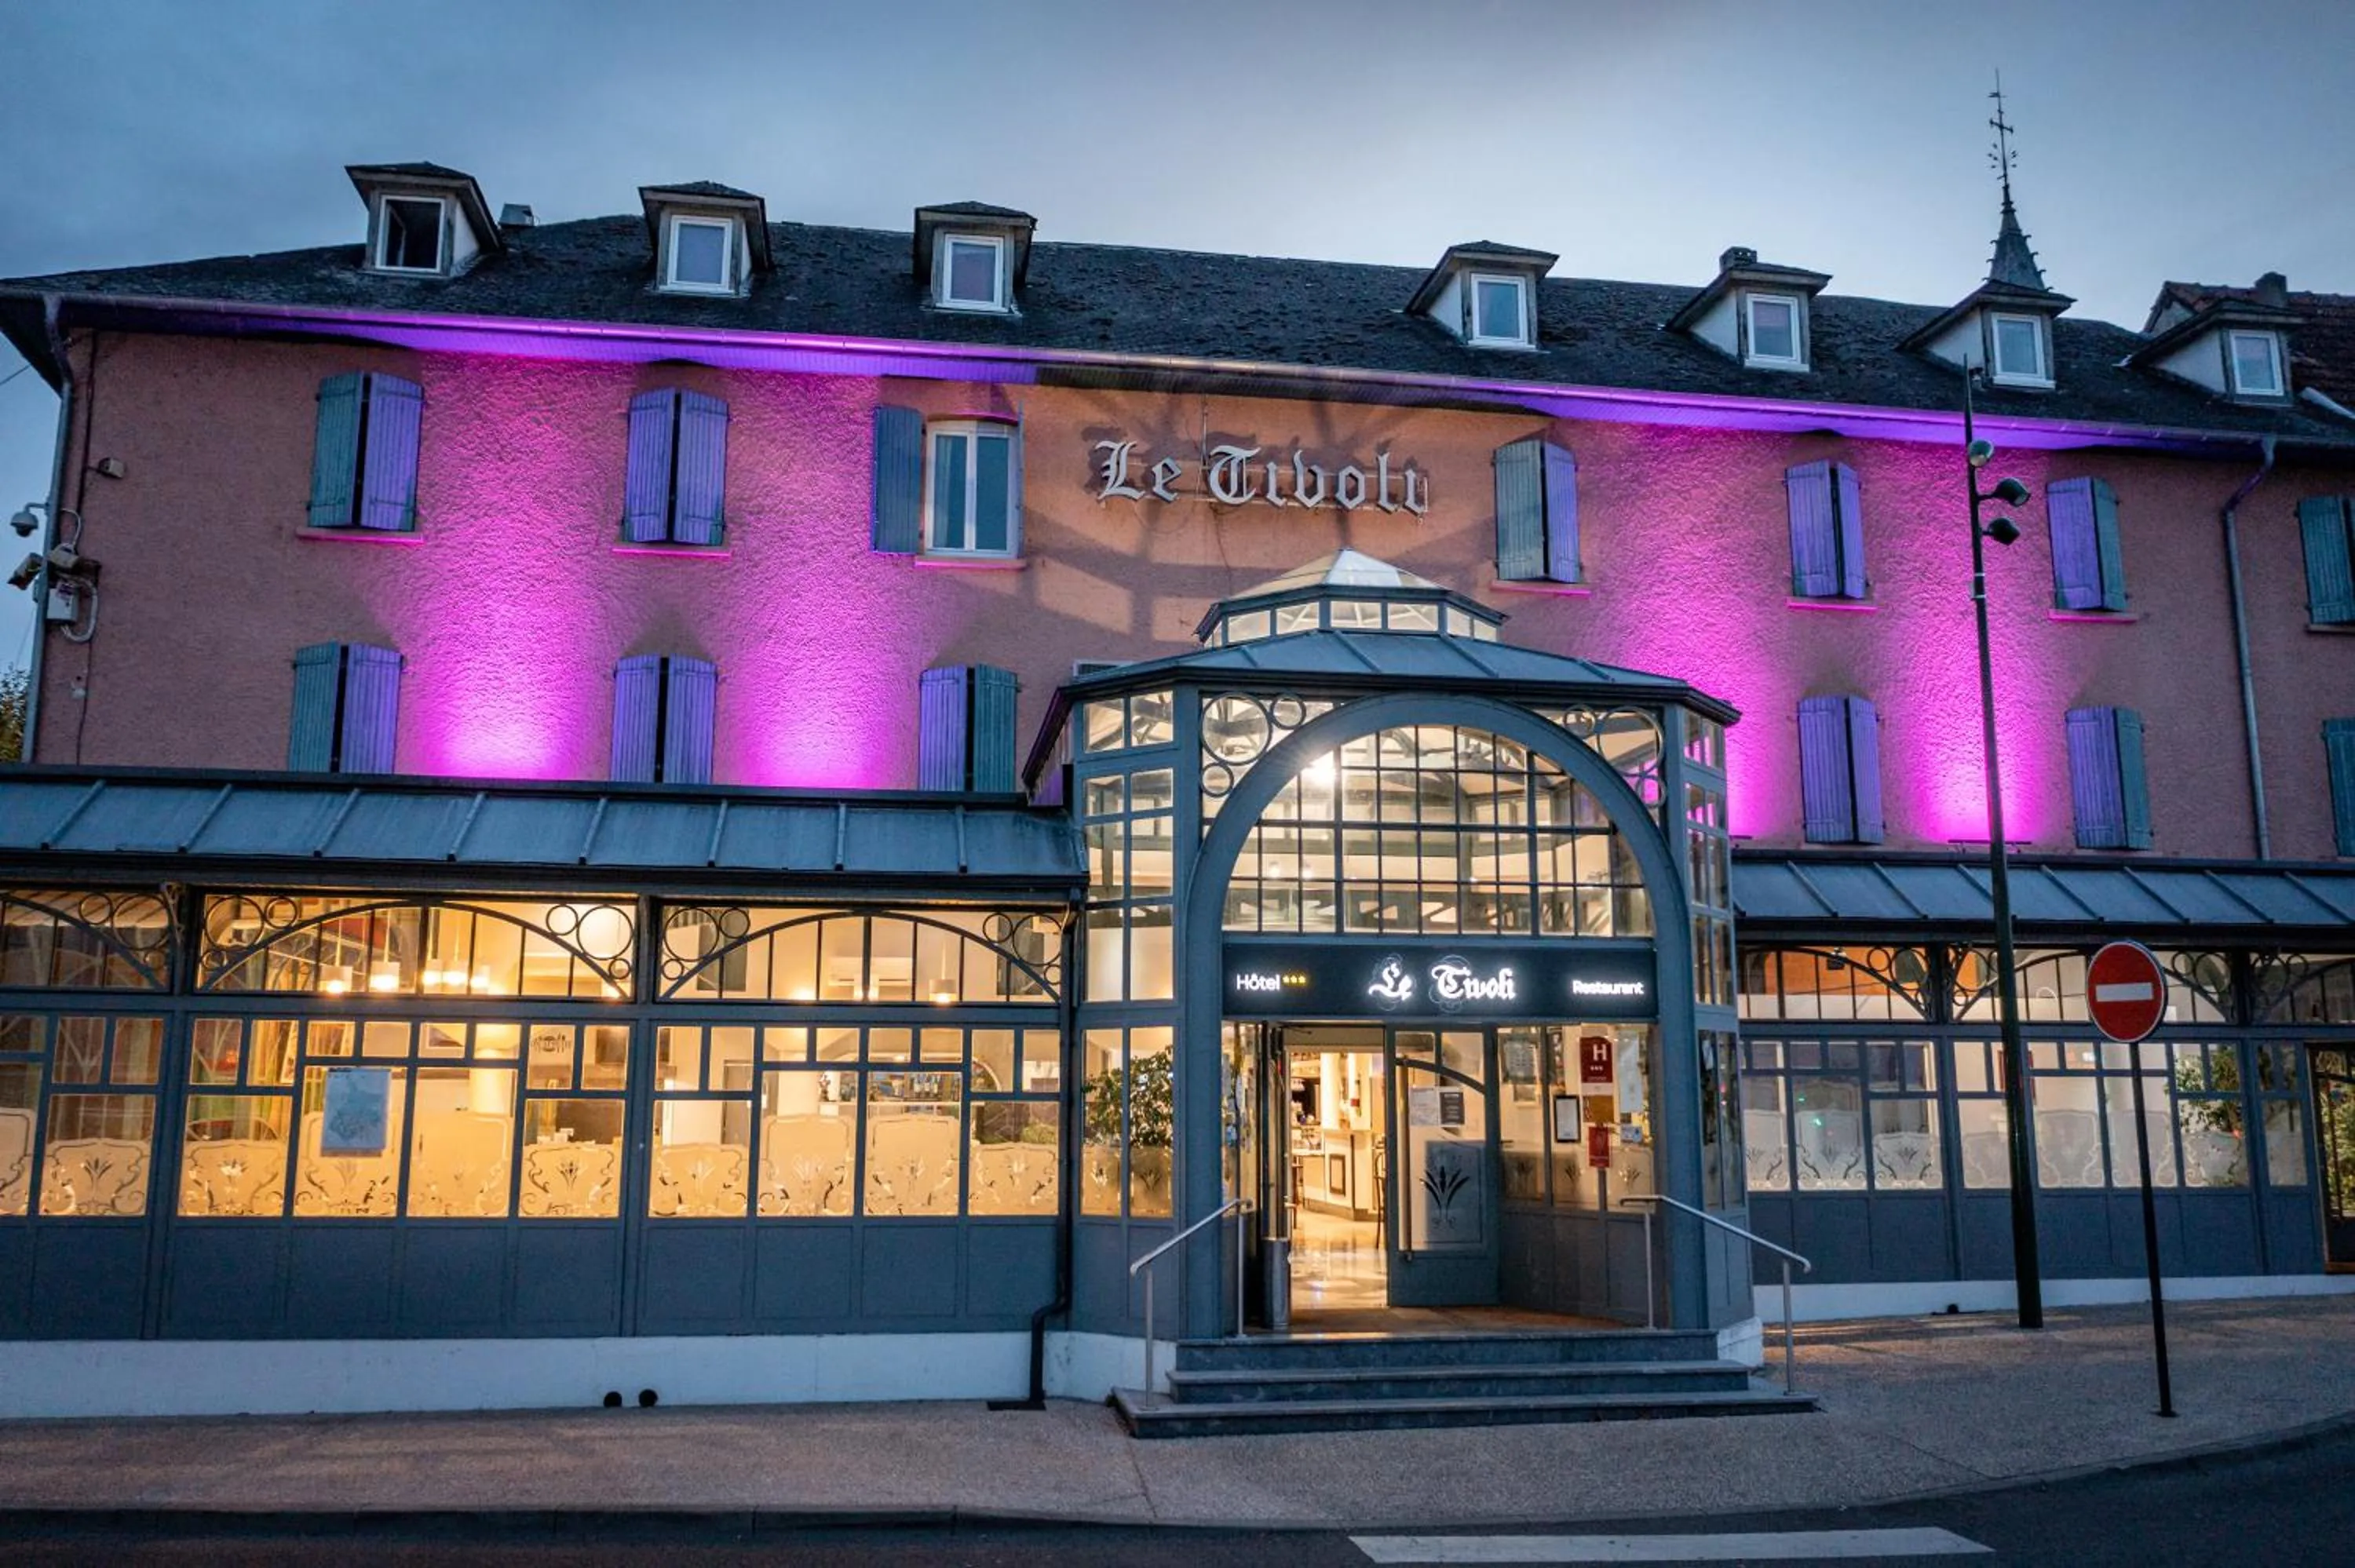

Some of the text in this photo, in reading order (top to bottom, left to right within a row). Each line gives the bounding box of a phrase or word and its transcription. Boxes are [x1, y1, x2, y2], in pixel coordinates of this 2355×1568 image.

[1095, 439, 1426, 515] Le Tivoli
[1236, 972, 1280, 991] Hôtel
[1368, 962, 1516, 1001] Le Tivoli
[1572, 979, 1645, 995] Restaurant
[1592, 1043, 1608, 1061] H
